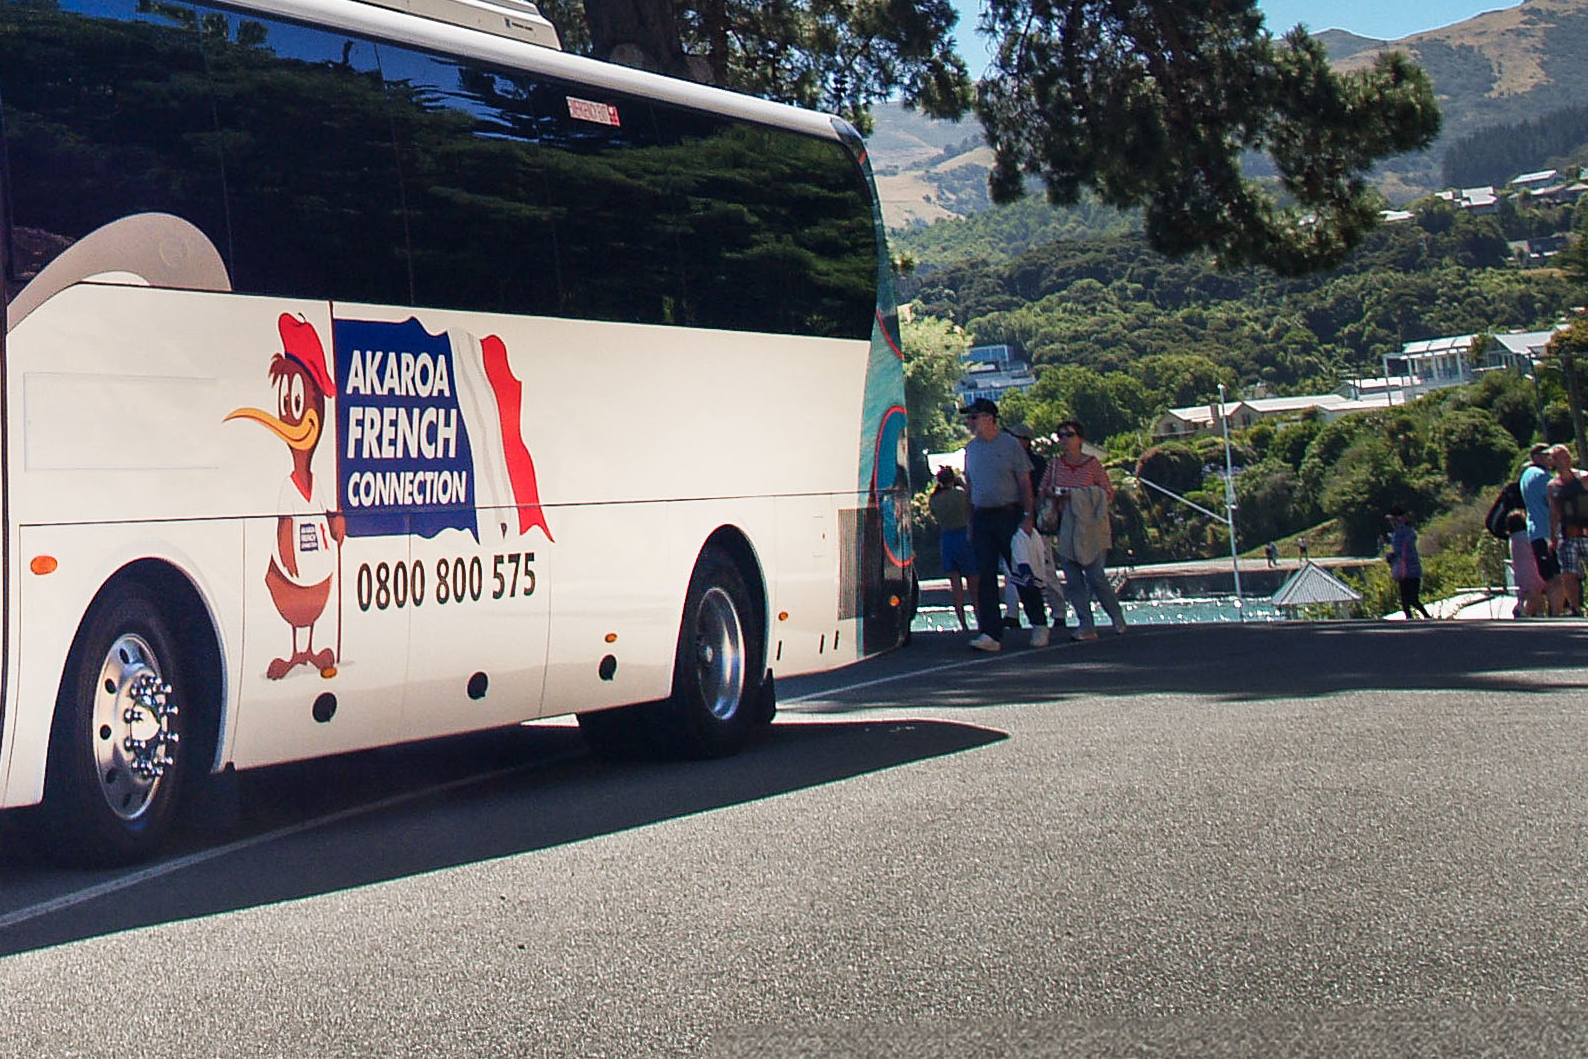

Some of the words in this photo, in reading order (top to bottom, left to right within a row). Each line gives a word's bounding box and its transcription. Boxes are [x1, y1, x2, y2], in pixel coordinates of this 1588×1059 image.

[346, 350, 450, 397] AKAROA
[347, 407, 457, 459] FRENCH
[347, 470, 467, 507] CONNECTION
[357, 559, 425, 611] 0800
[436, 556, 483, 604] 800
[492, 552, 536, 600] 575
